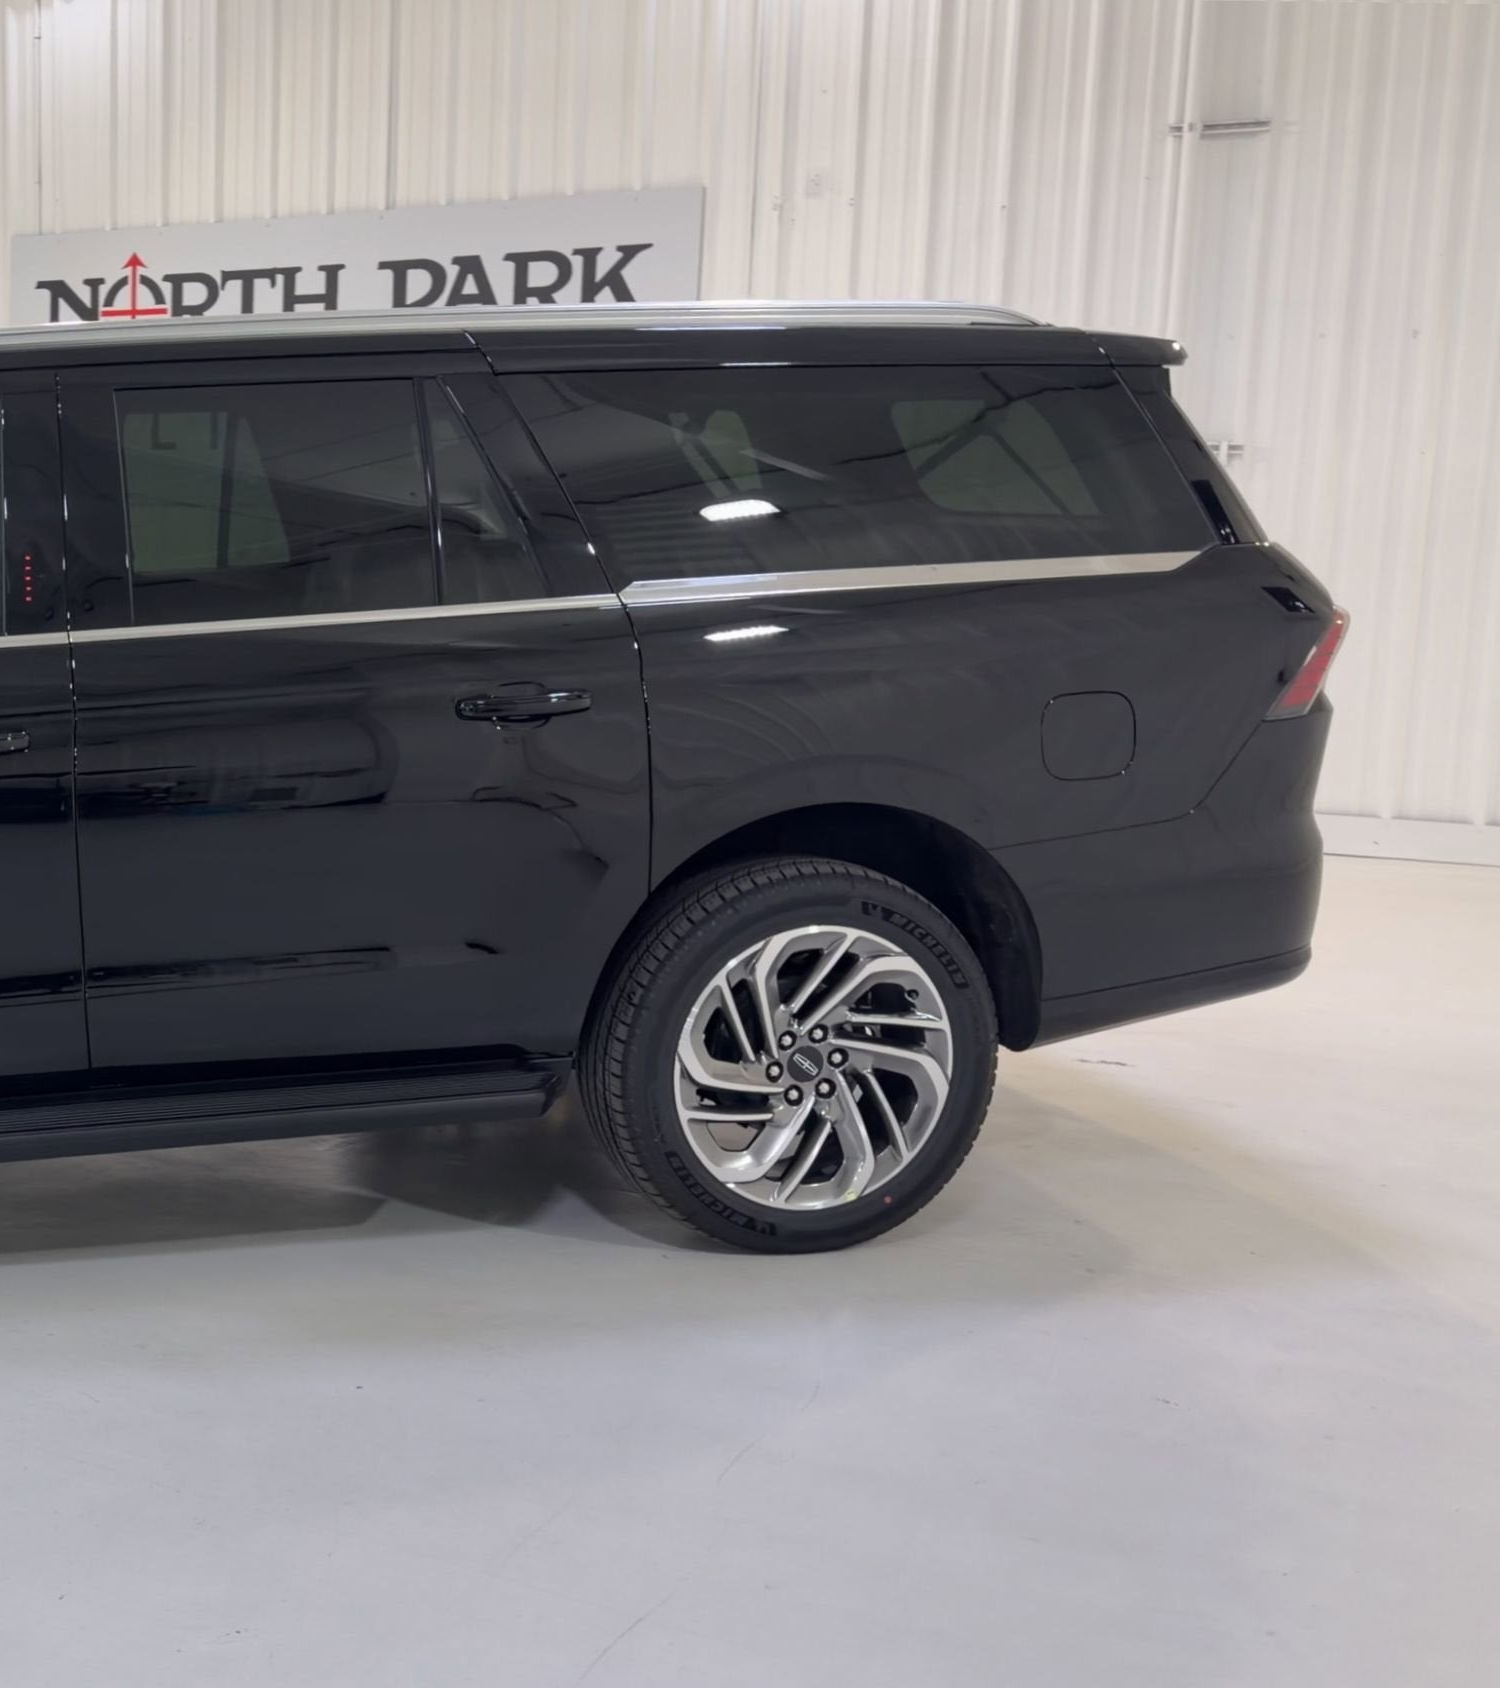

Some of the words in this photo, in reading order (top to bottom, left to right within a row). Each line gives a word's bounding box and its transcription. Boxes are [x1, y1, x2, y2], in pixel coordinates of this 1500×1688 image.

[35, 264, 345, 322] NORTH
[377, 243, 654, 307] PARK
[889, 913, 967, 985] MICHELIN
